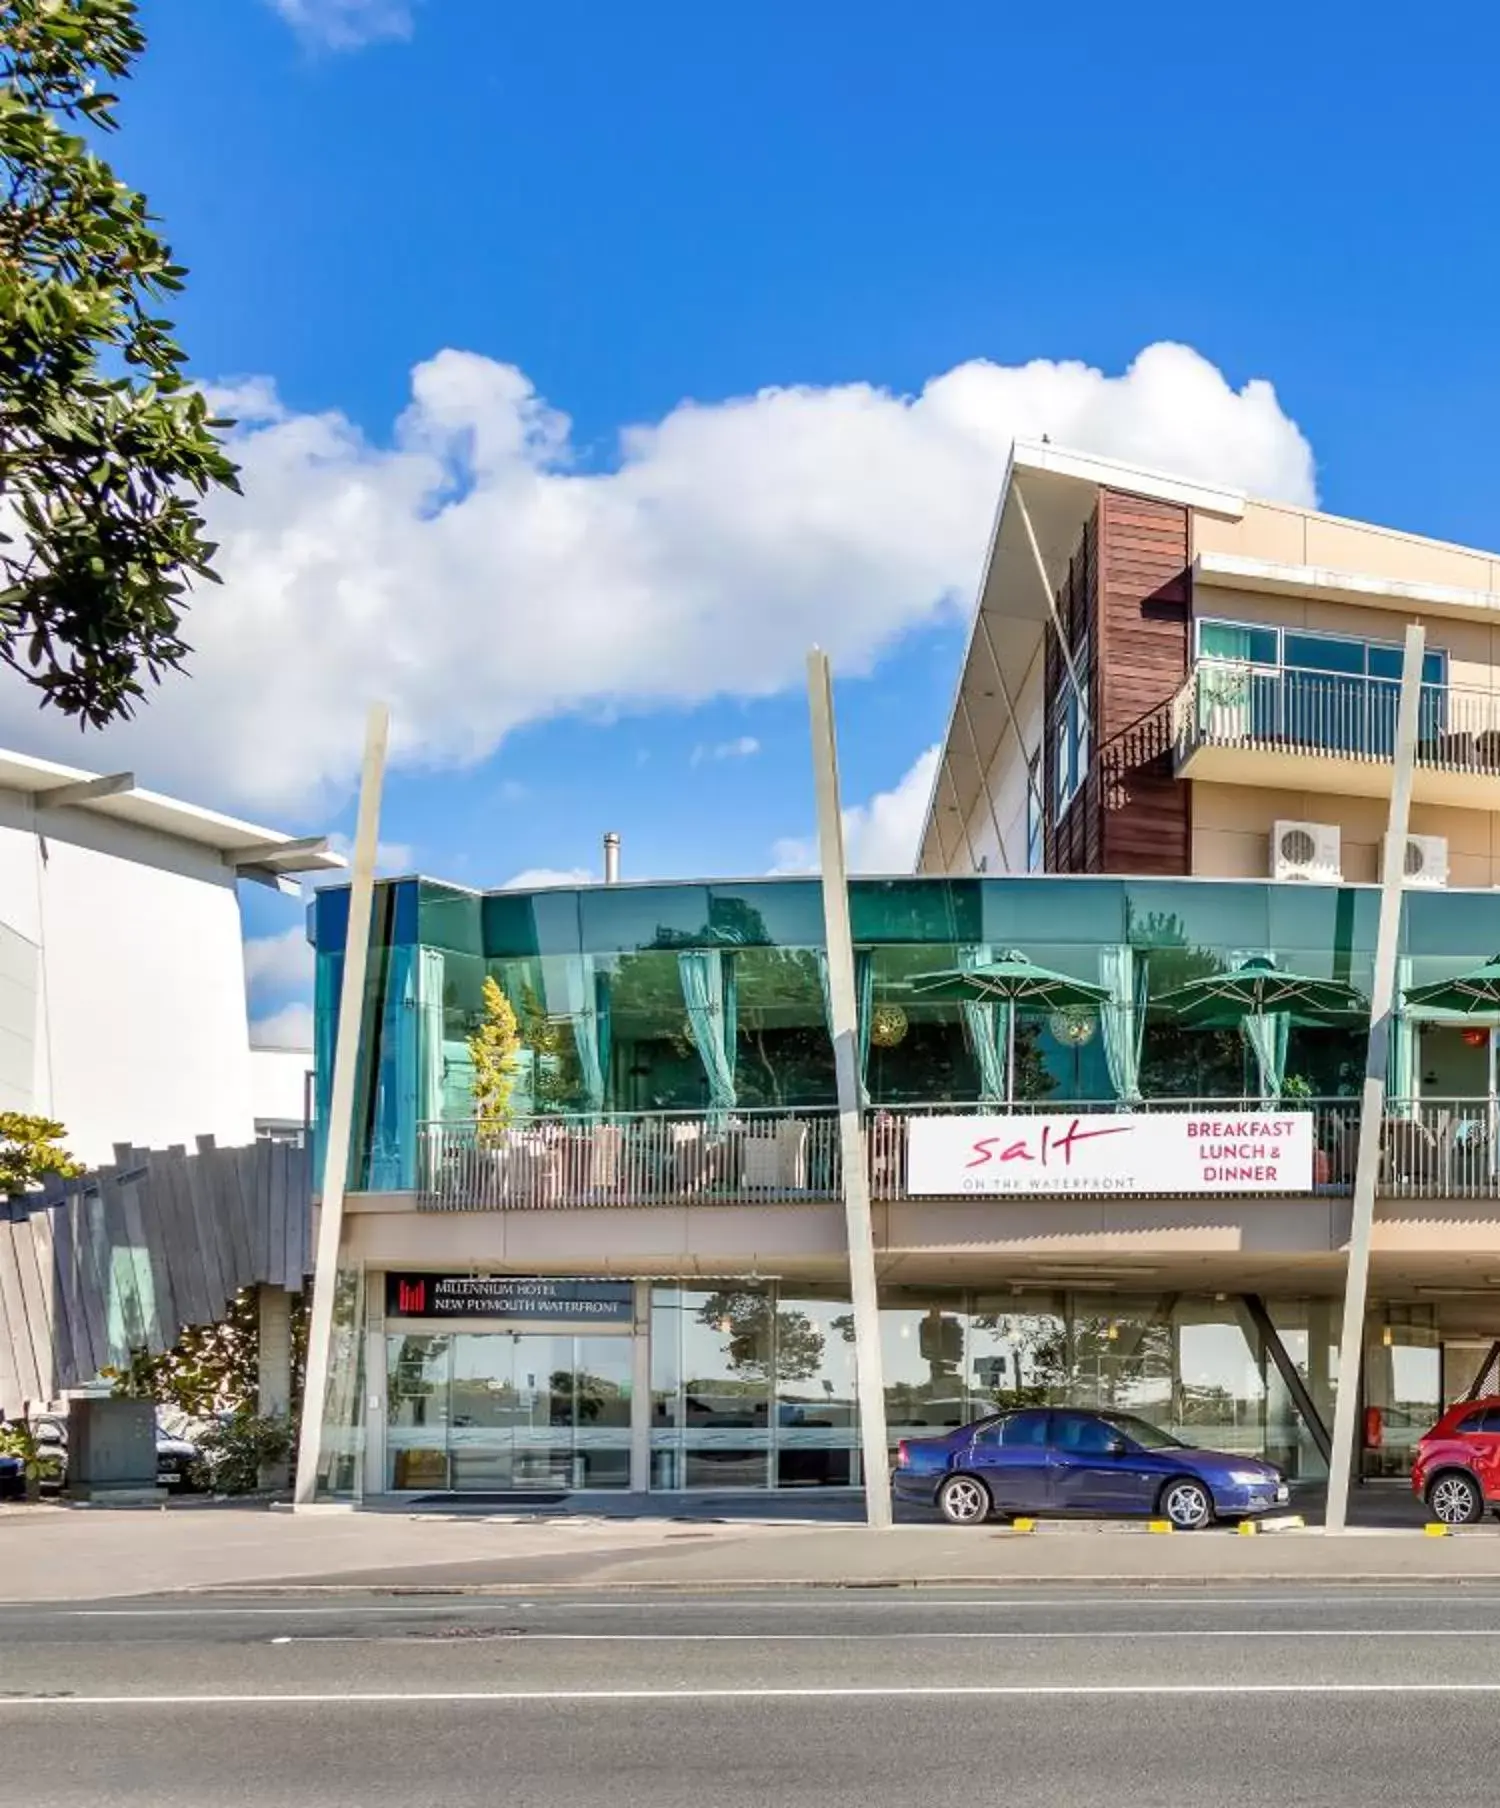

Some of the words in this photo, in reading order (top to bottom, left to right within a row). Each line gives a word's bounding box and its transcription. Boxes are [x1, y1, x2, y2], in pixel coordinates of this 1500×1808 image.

[1187, 1121, 1294, 1137] BREAKFAST
[965, 1119, 1136, 1168] salt
[1200, 1143, 1265, 1159] LUNCH
[1270, 1146, 1280, 1159] &
[1203, 1165, 1277, 1181] DINNER
[963, 1178, 985, 1190] ON
[994, 1178, 1019, 1190] THE
[1030, 1177, 1137, 1190] WATERFRONT
[435, 1281, 513, 1295] MILLENNIUM
[517, 1283, 557, 1296] HOTEL
[435, 1299, 465, 1310] NEW
[467, 1299, 535, 1311] PLYMOUTH
[537, 1301, 619, 1313] WATERFRONT
